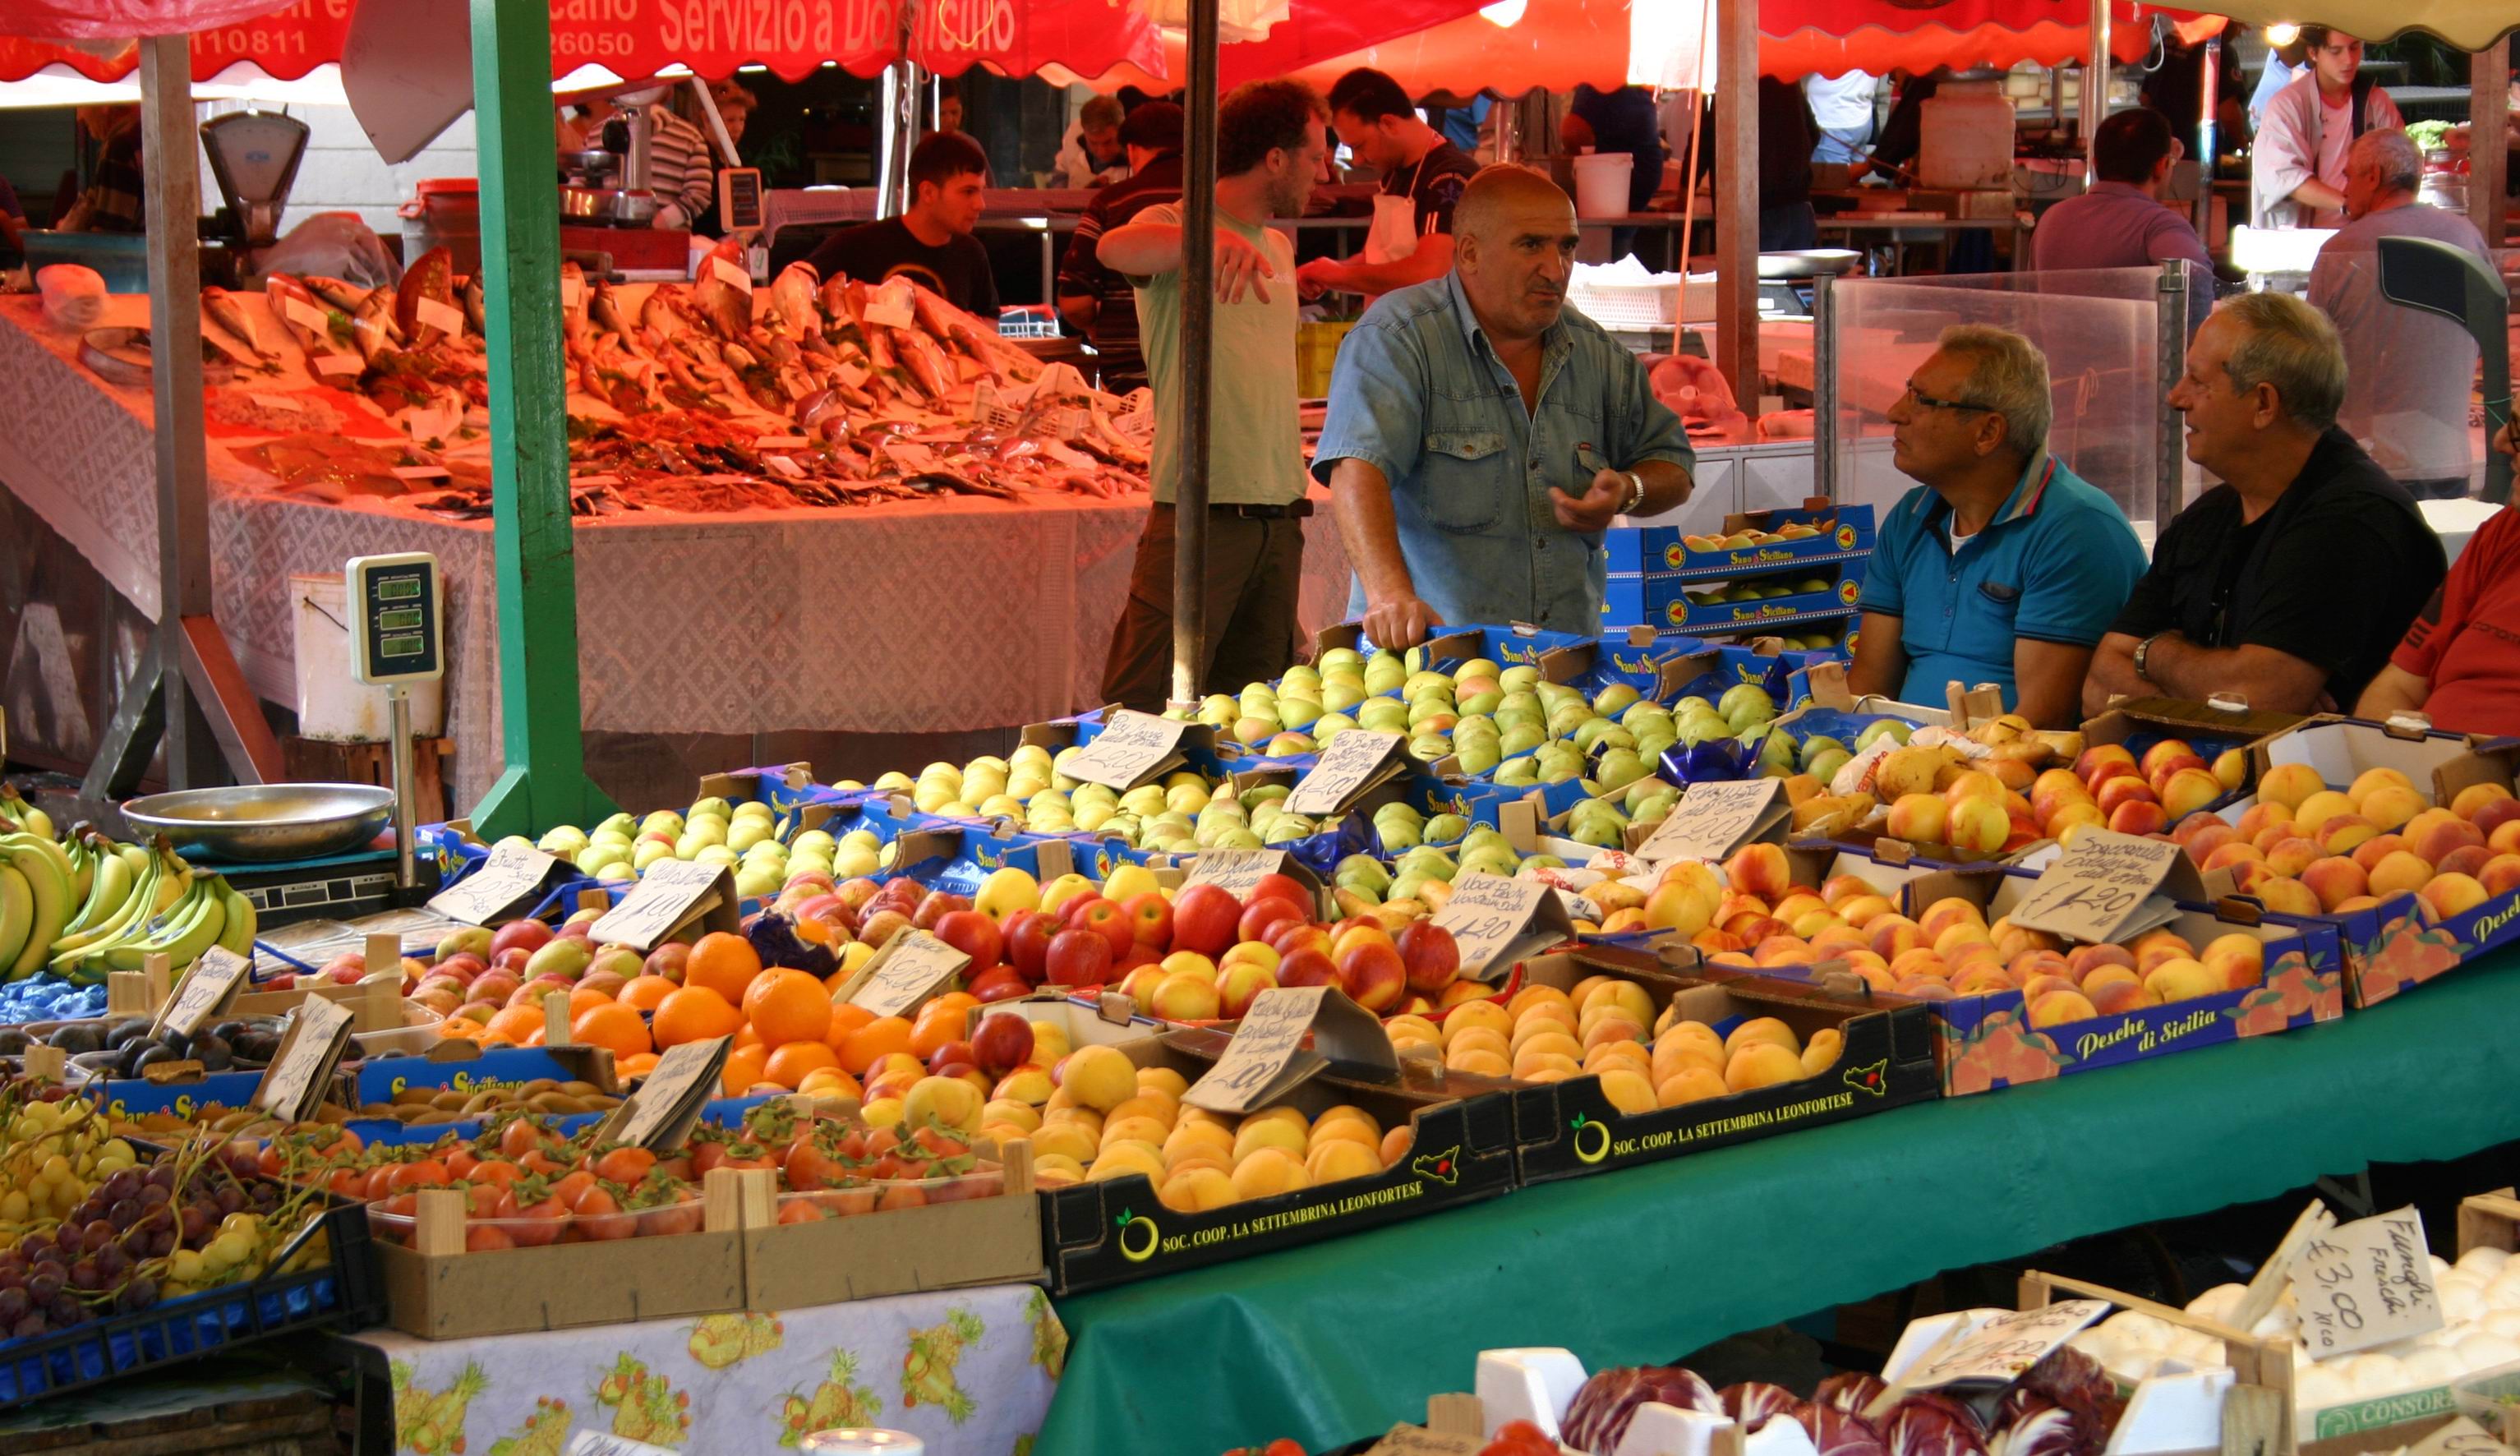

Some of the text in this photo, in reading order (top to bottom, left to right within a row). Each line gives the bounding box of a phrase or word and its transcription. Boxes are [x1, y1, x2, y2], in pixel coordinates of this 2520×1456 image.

[660, 0, 808, 52] Servizio
[813, 0, 833, 51] a
[2076, 1015, 2148, 1060] Pesche
[2138, 1008, 2217, 1053] di Sicilia
[1614, 1091, 1854, 1157] SOC. COOP. LA SETTEMBRINA LEONFORTESE
[1162, 1180, 1424, 1253] SOC. COOP. LA SETTEMBRINA LEONFORTESE
[2361, 1389, 2456, 1424] CONSOR
